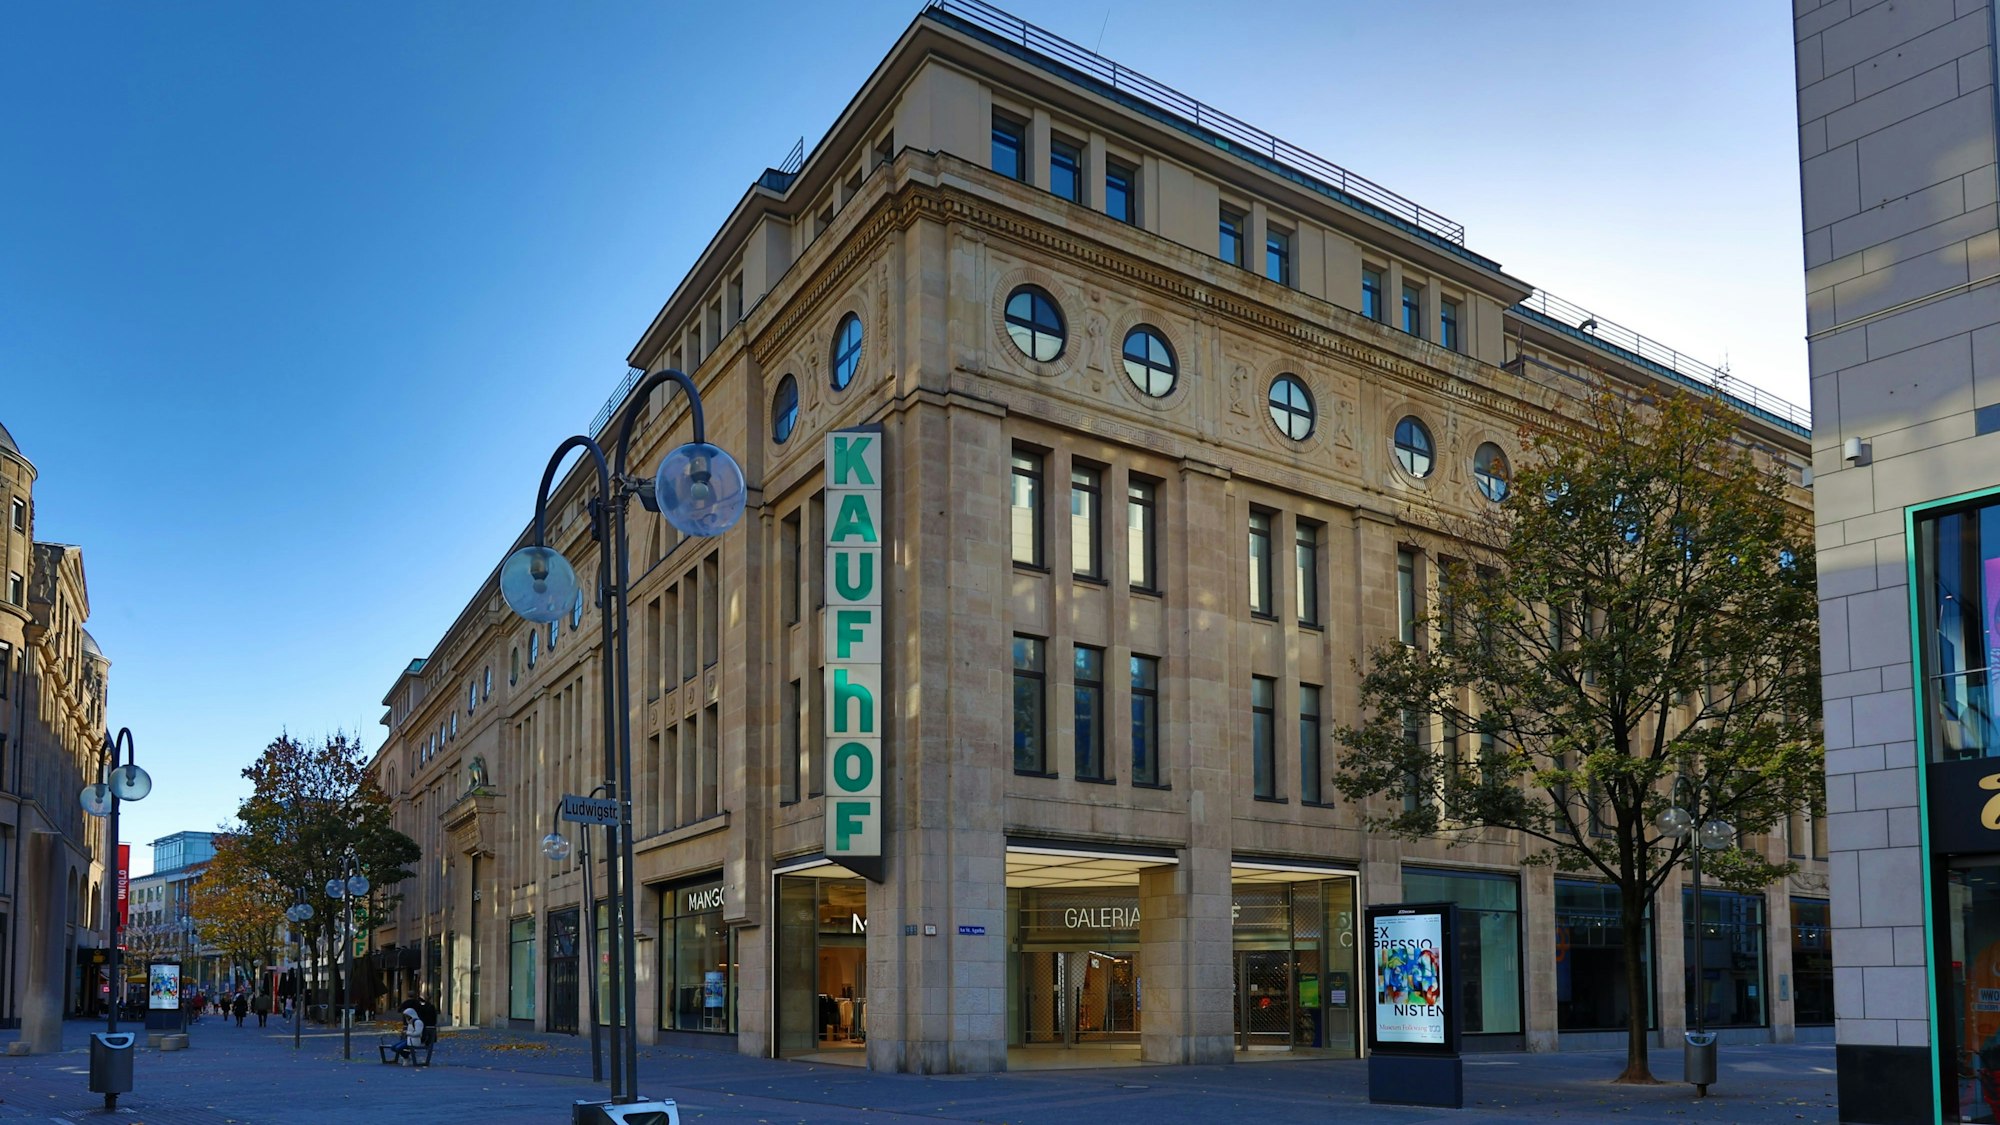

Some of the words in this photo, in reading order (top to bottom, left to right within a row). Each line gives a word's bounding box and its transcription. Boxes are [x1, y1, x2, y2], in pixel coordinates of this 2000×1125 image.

[565, 799, 618, 821] Ludwigstr.
[118, 869, 127, 900] UNIQLO
[1064, 907, 1141, 929] GALERIA
[1394, 1004, 1445, 1017] NISTEN
